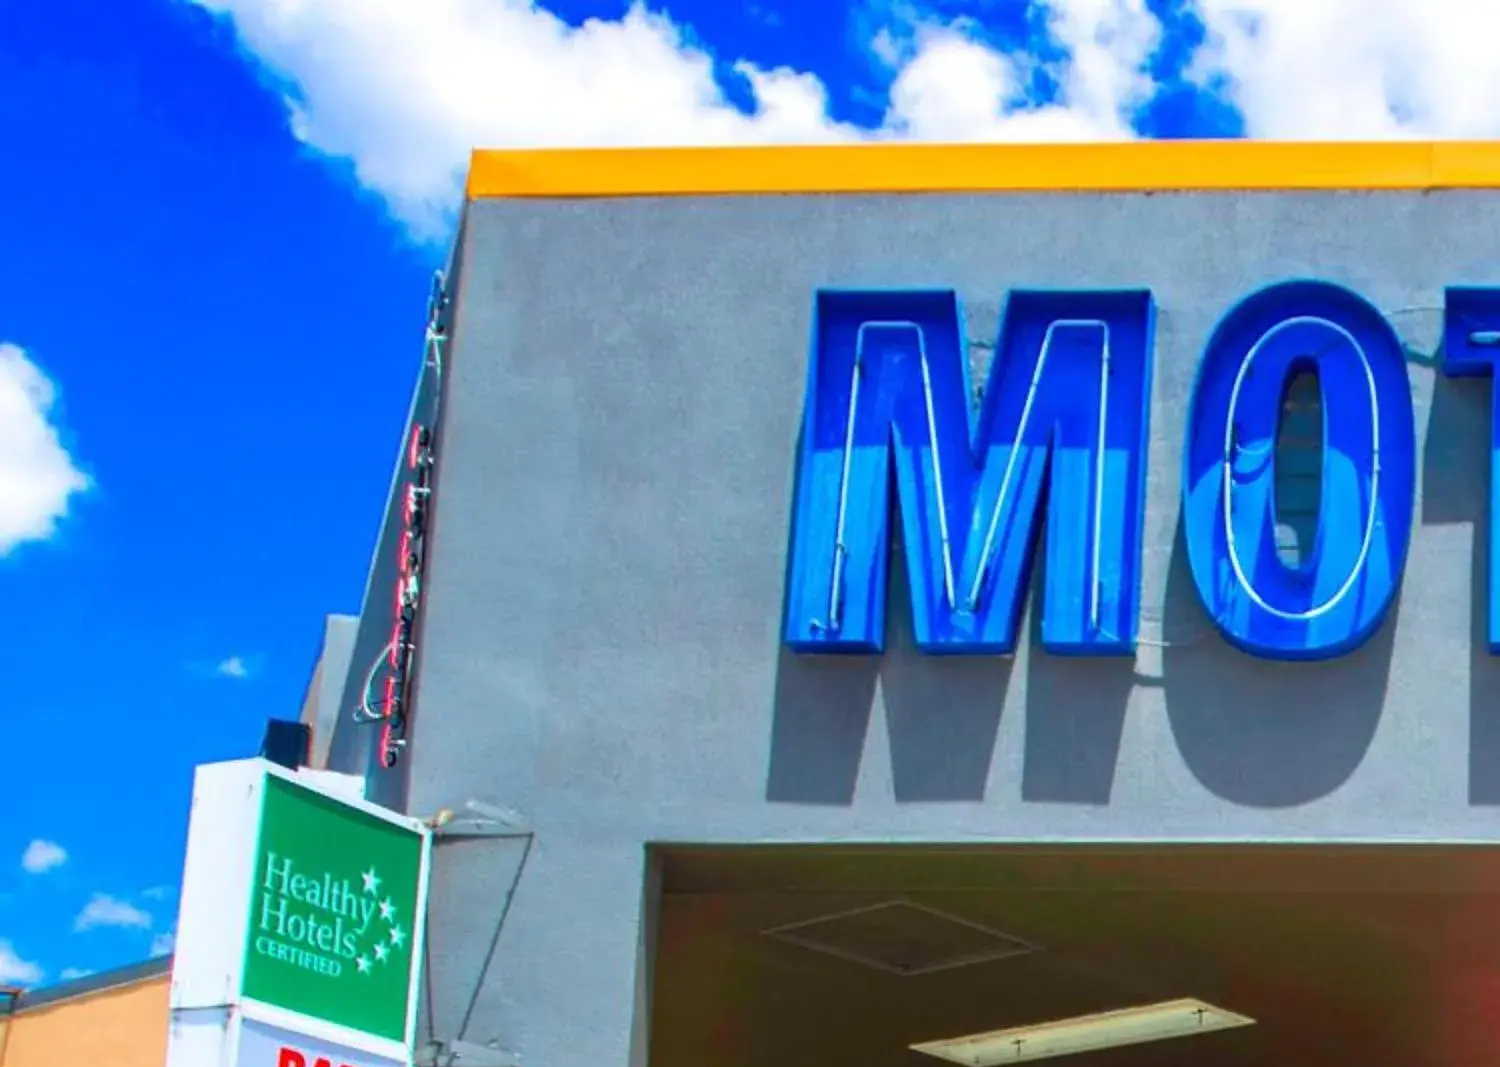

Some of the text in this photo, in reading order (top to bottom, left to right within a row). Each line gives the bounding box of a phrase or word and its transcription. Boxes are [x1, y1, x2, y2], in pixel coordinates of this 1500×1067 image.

[258, 892, 357, 959] Hotels
[264, 850, 375, 935] Healthy
[255, 936, 342, 979] CERTIFIED
